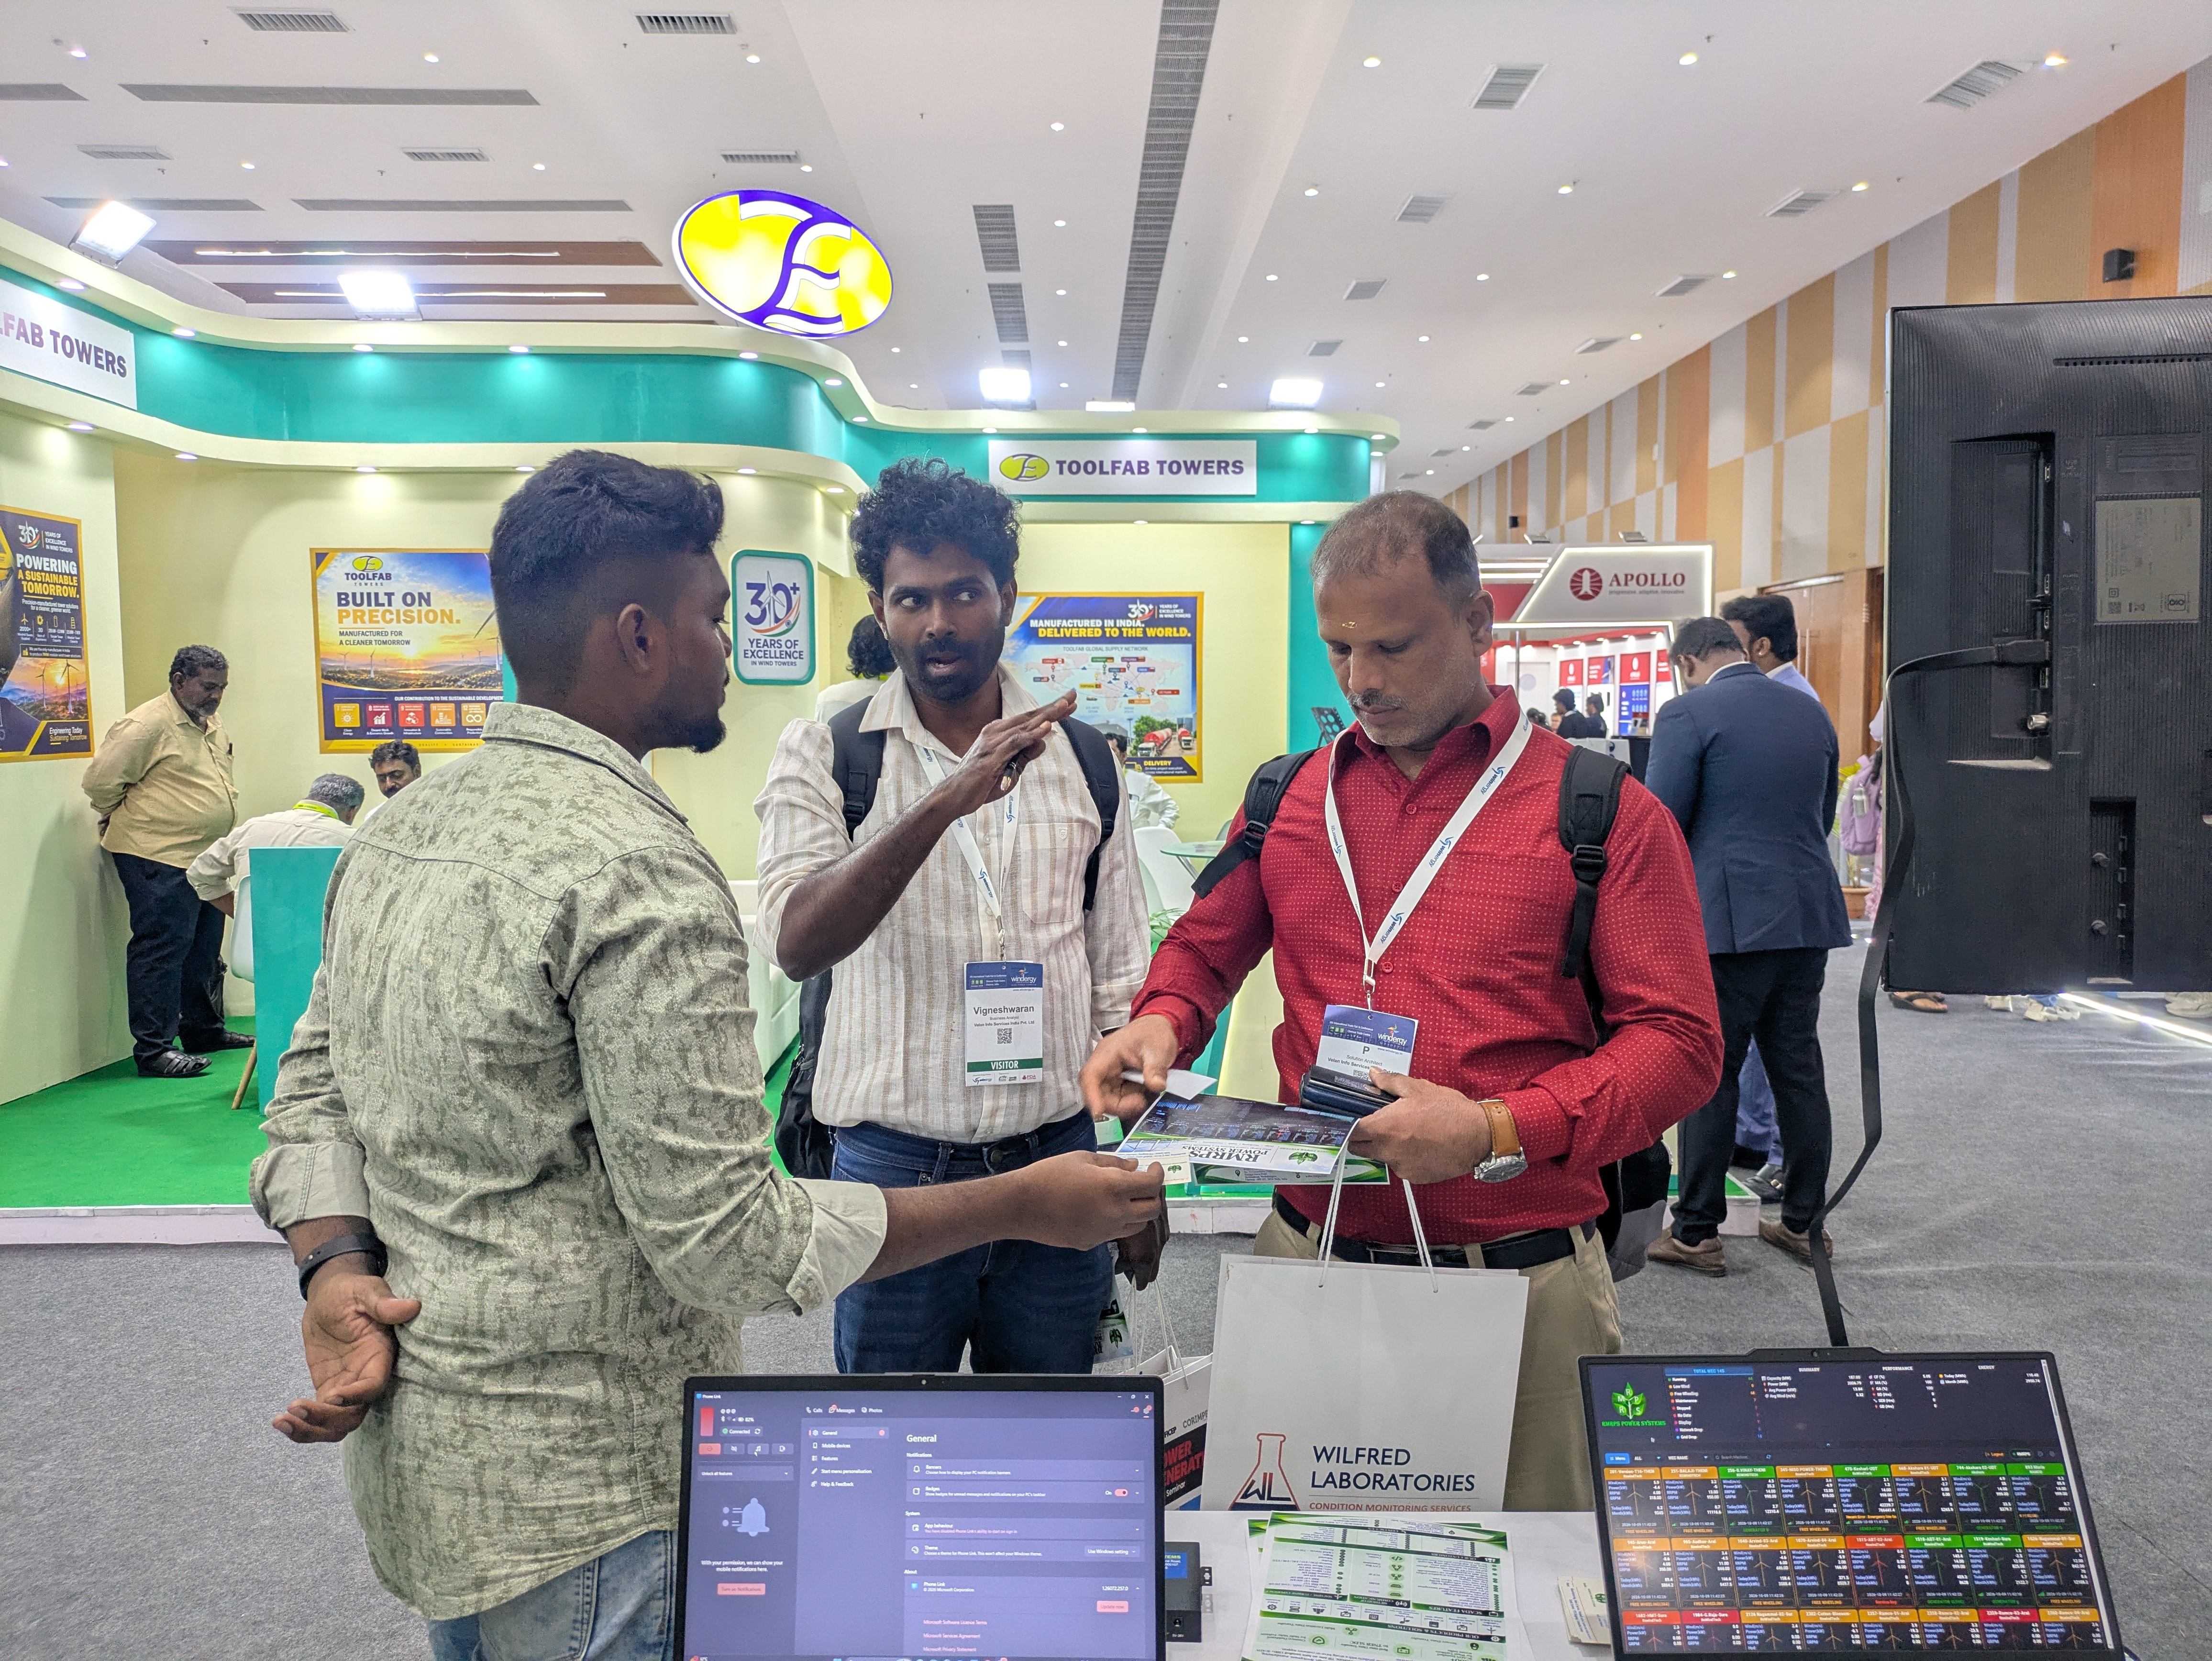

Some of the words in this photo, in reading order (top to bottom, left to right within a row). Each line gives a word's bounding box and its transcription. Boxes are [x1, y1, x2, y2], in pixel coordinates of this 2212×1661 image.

[0, 312, 44, 348] FAB
[50, 329, 127, 378] TOWERS
[1056, 460, 1150, 475] TOOLFAB
[1157, 460, 1244, 475] TOWERS
[16, 554, 77, 575] POWERING
[18, 569, 24, 579] A
[25, 571, 78, 586] SUSTAINABLE
[344, 573, 392, 581] TOOLFAB
[1609, 573, 1685, 587] APOLLO
[22, 581, 79, 598] TOMORROW.
[337, 592, 395, 607] BUILT
[402, 591, 431, 607] ON
[338, 609, 461, 624] PRECISION.
[1039, 628, 1102, 637] DELIVERED
[1105, 628, 1119, 637] TO
[1122, 628, 1143, 637] THE
[1146, 628, 1191, 637] WORLD.
[748, 638, 782, 649] YEARS
[785, 640, 799, 649] OF
[743, 649, 804, 660] EXCELLENCE
[1480, 773, 1498, 795] winergy
[1429, 843, 1446, 868] winergy
[1381, 919, 1397, 944] winergy
[1011, 974, 1037, 983] windergy
[973, 1006, 1034, 1016] Vigneshwaran
[1378, 1032, 1407, 1046] windergy
[991, 1061, 1018, 1070] VISITOR
[1183, 1409, 1208, 1428] CORIMPE
[1313, 1445, 1411, 1465] WILFRED
[1166, 1482, 1185, 1497] Seminar
[1311, 1472, 1475, 1492] LABORATORIES
[1309, 1503, 1363, 1511] CONDITION
[1365, 1504, 1427, 1512] MONITORING
[1387, 1624, 1422, 1632] SOLUTIONS
[1430, 1628, 1464, 1637] PRODUCTS
